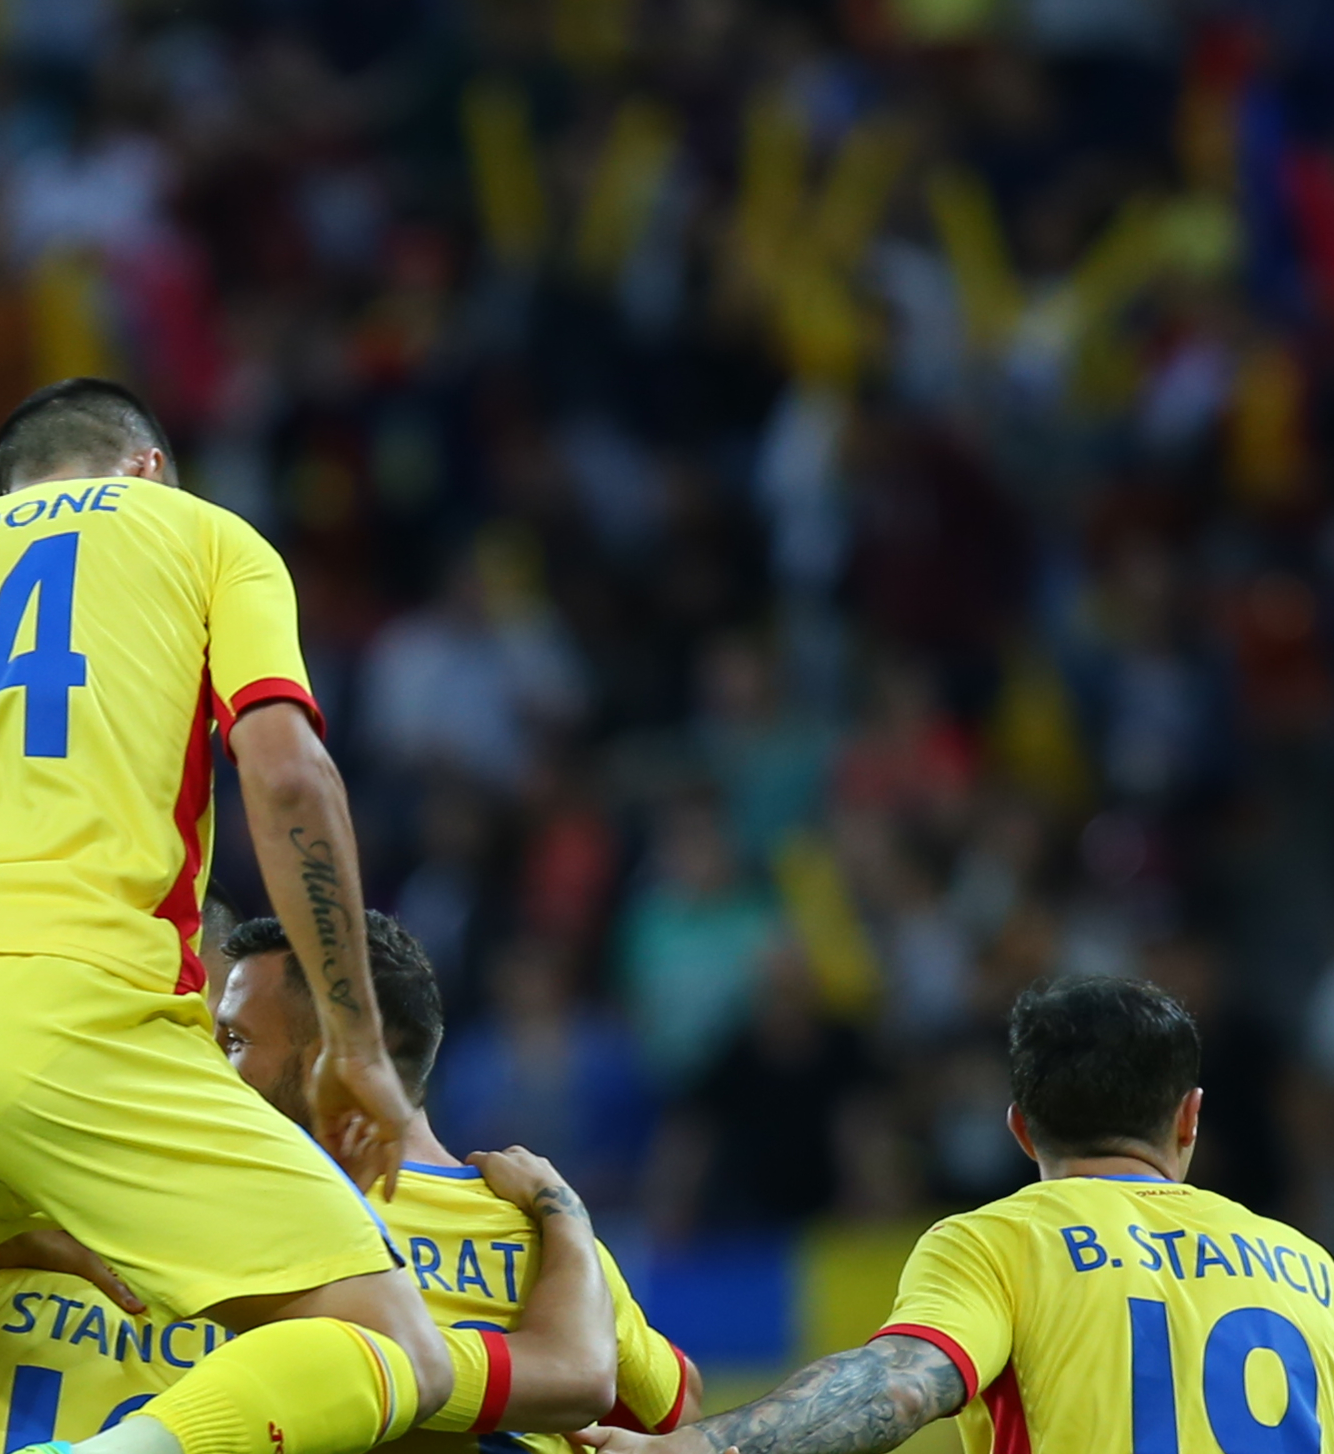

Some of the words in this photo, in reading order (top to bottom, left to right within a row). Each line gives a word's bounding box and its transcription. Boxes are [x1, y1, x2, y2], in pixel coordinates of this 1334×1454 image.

[409, 1237, 525, 1303] RAT
[1061, 1225, 1123, 1273] B.
[1129, 1225, 1332, 1308] STANCU
[2, 1291, 238, 1368] STANCI
